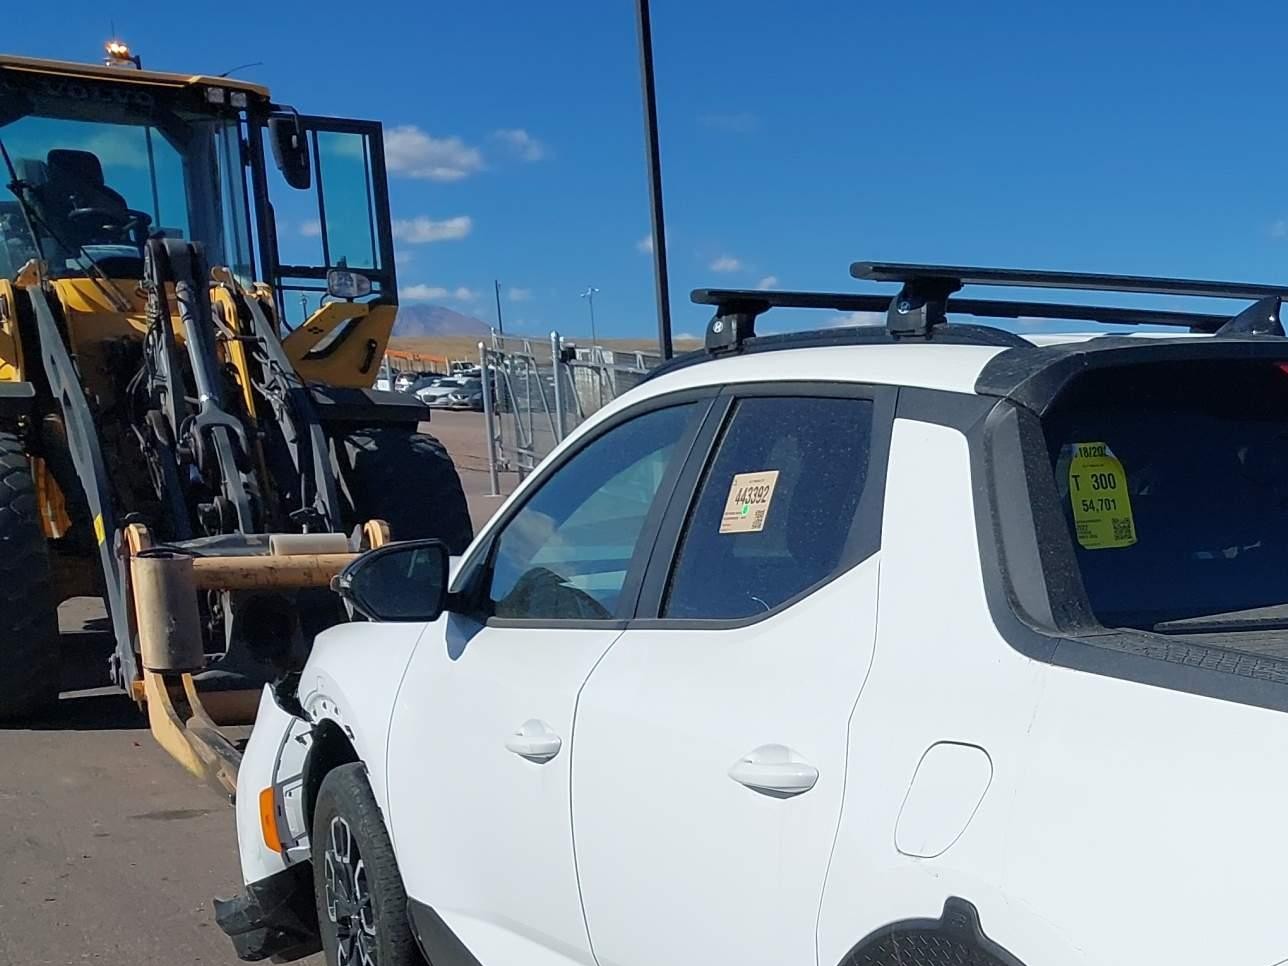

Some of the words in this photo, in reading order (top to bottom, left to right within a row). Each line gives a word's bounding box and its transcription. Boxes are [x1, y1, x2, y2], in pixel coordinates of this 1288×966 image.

[1071, 474, 1081, 492] T
[1091, 472, 1117, 491] 300
[734, 484, 770, 506] 443392
[1081, 498, 1118, 514] 54.701
